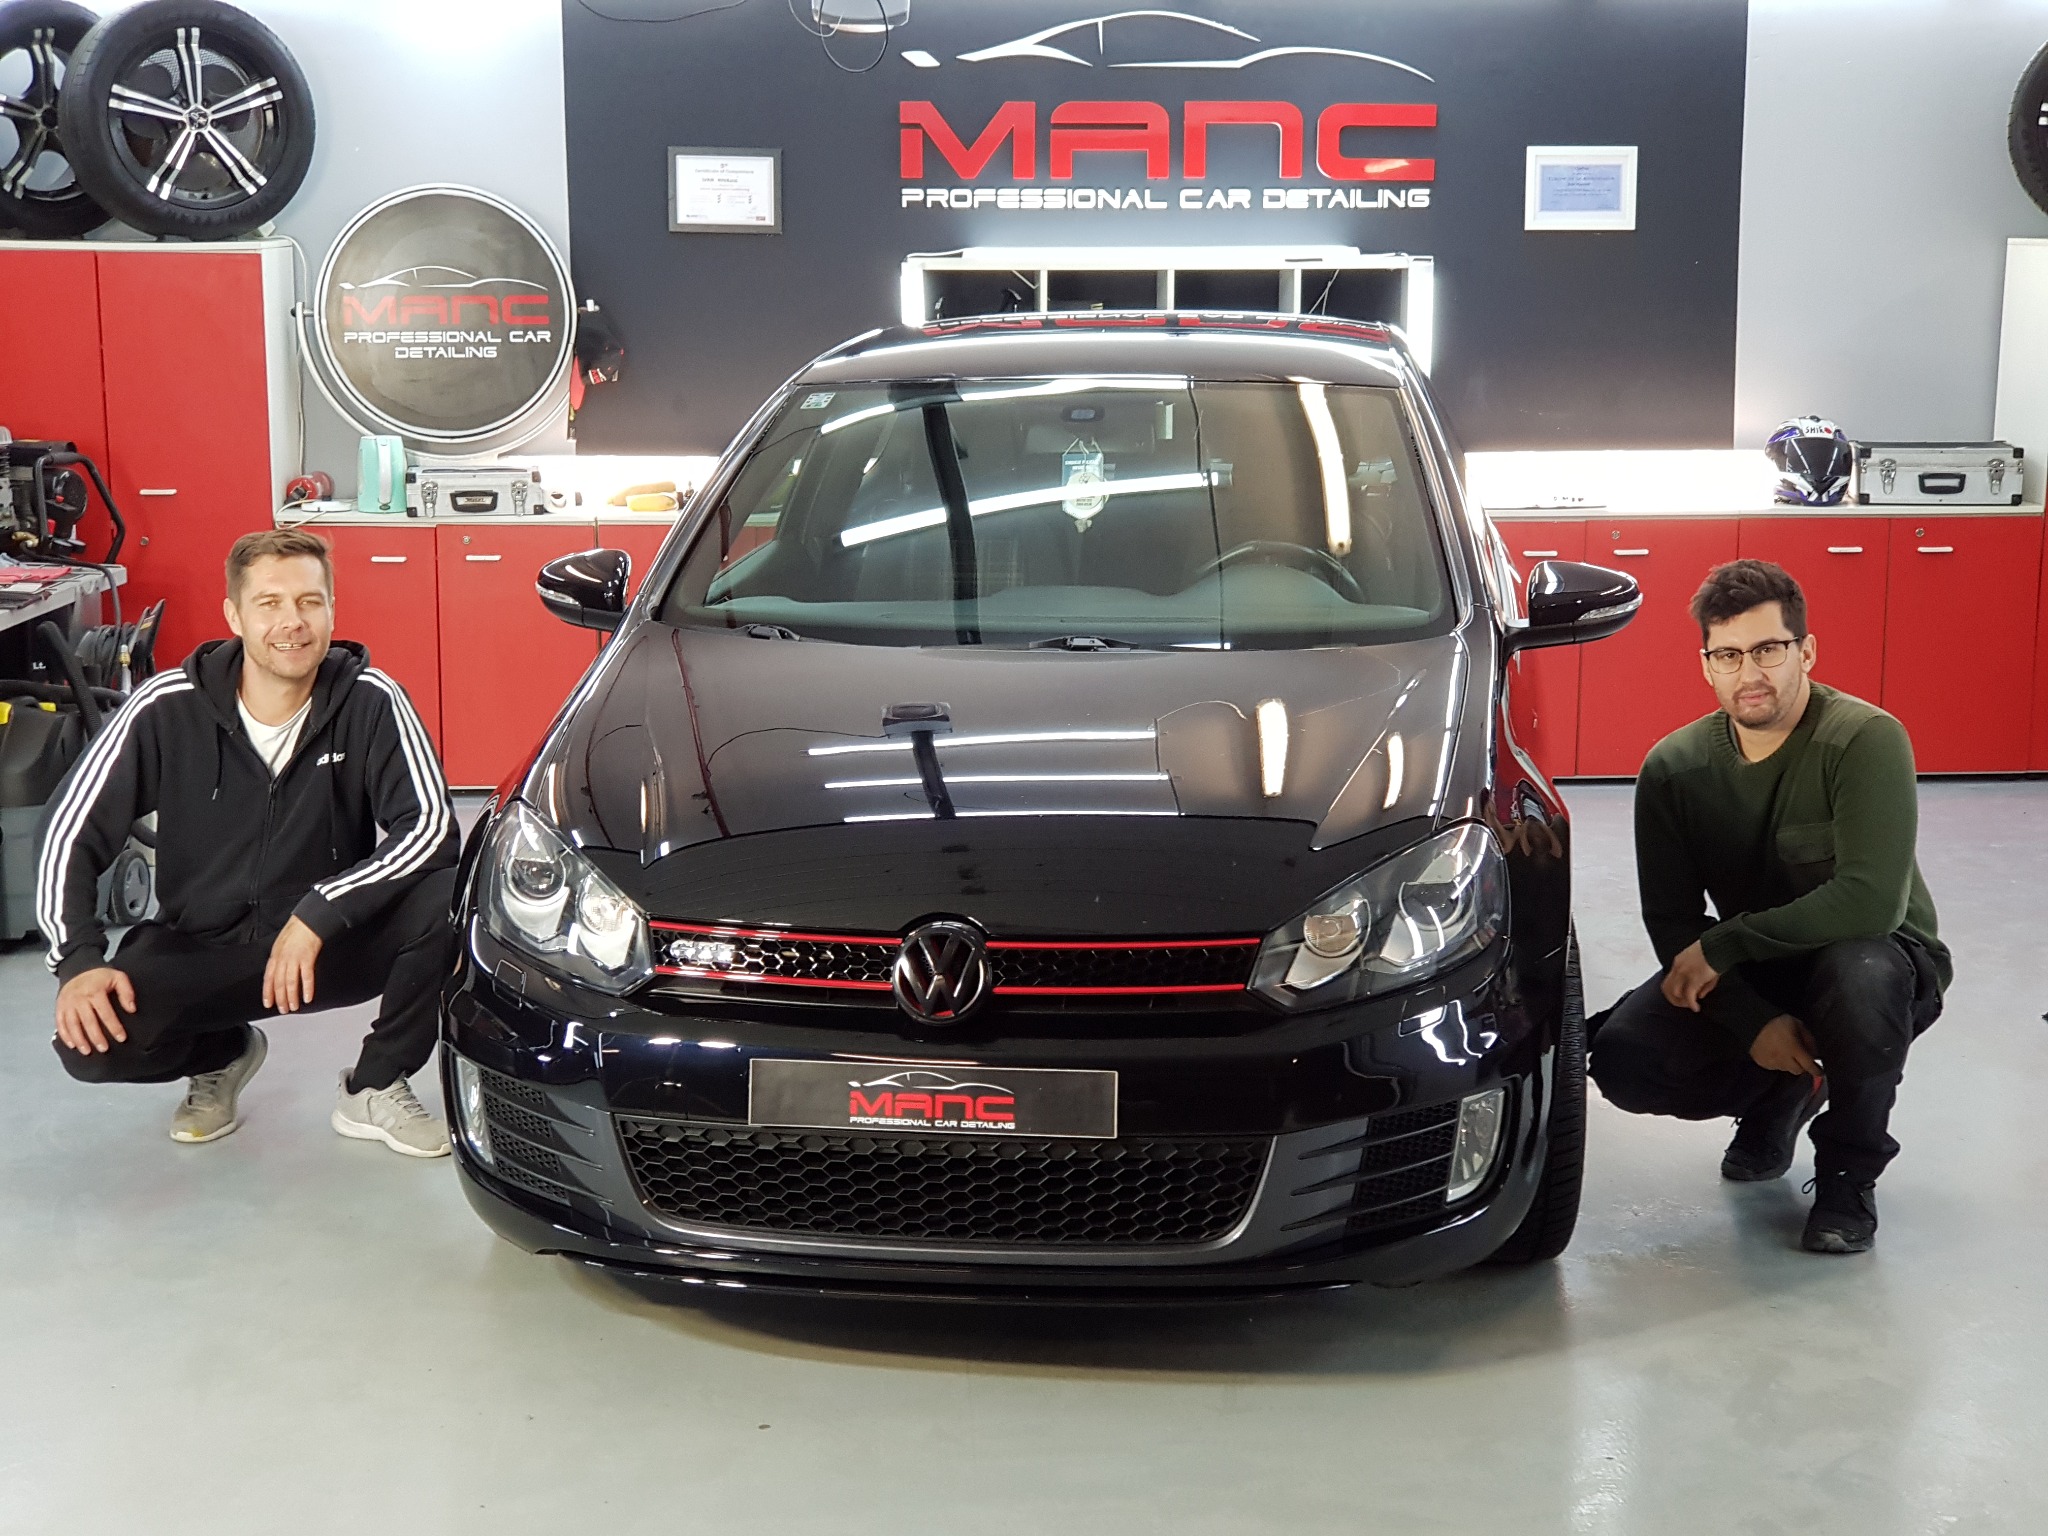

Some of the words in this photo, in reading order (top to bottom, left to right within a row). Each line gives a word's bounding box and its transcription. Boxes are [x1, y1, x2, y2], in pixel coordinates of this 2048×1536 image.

[899, 101, 1438, 181] MANC
[901, 188, 1168, 210] PROFESSIONAL
[1179, 188, 1252, 210] CAR
[1262, 188, 1431, 210] DETAILING
[343, 294, 550, 325] MANC
[343, 330, 502, 344] PROFESSIONAL
[509, 330, 551, 343] CAR
[394, 346, 498, 359] DETAILING
[849, 1090, 1015, 1121] MANC
[849, 1116, 931, 1127] PROFESSIONAL
[934, 1119, 958, 1128] CAR
[960, 1119, 1016, 1130] DETAILING
